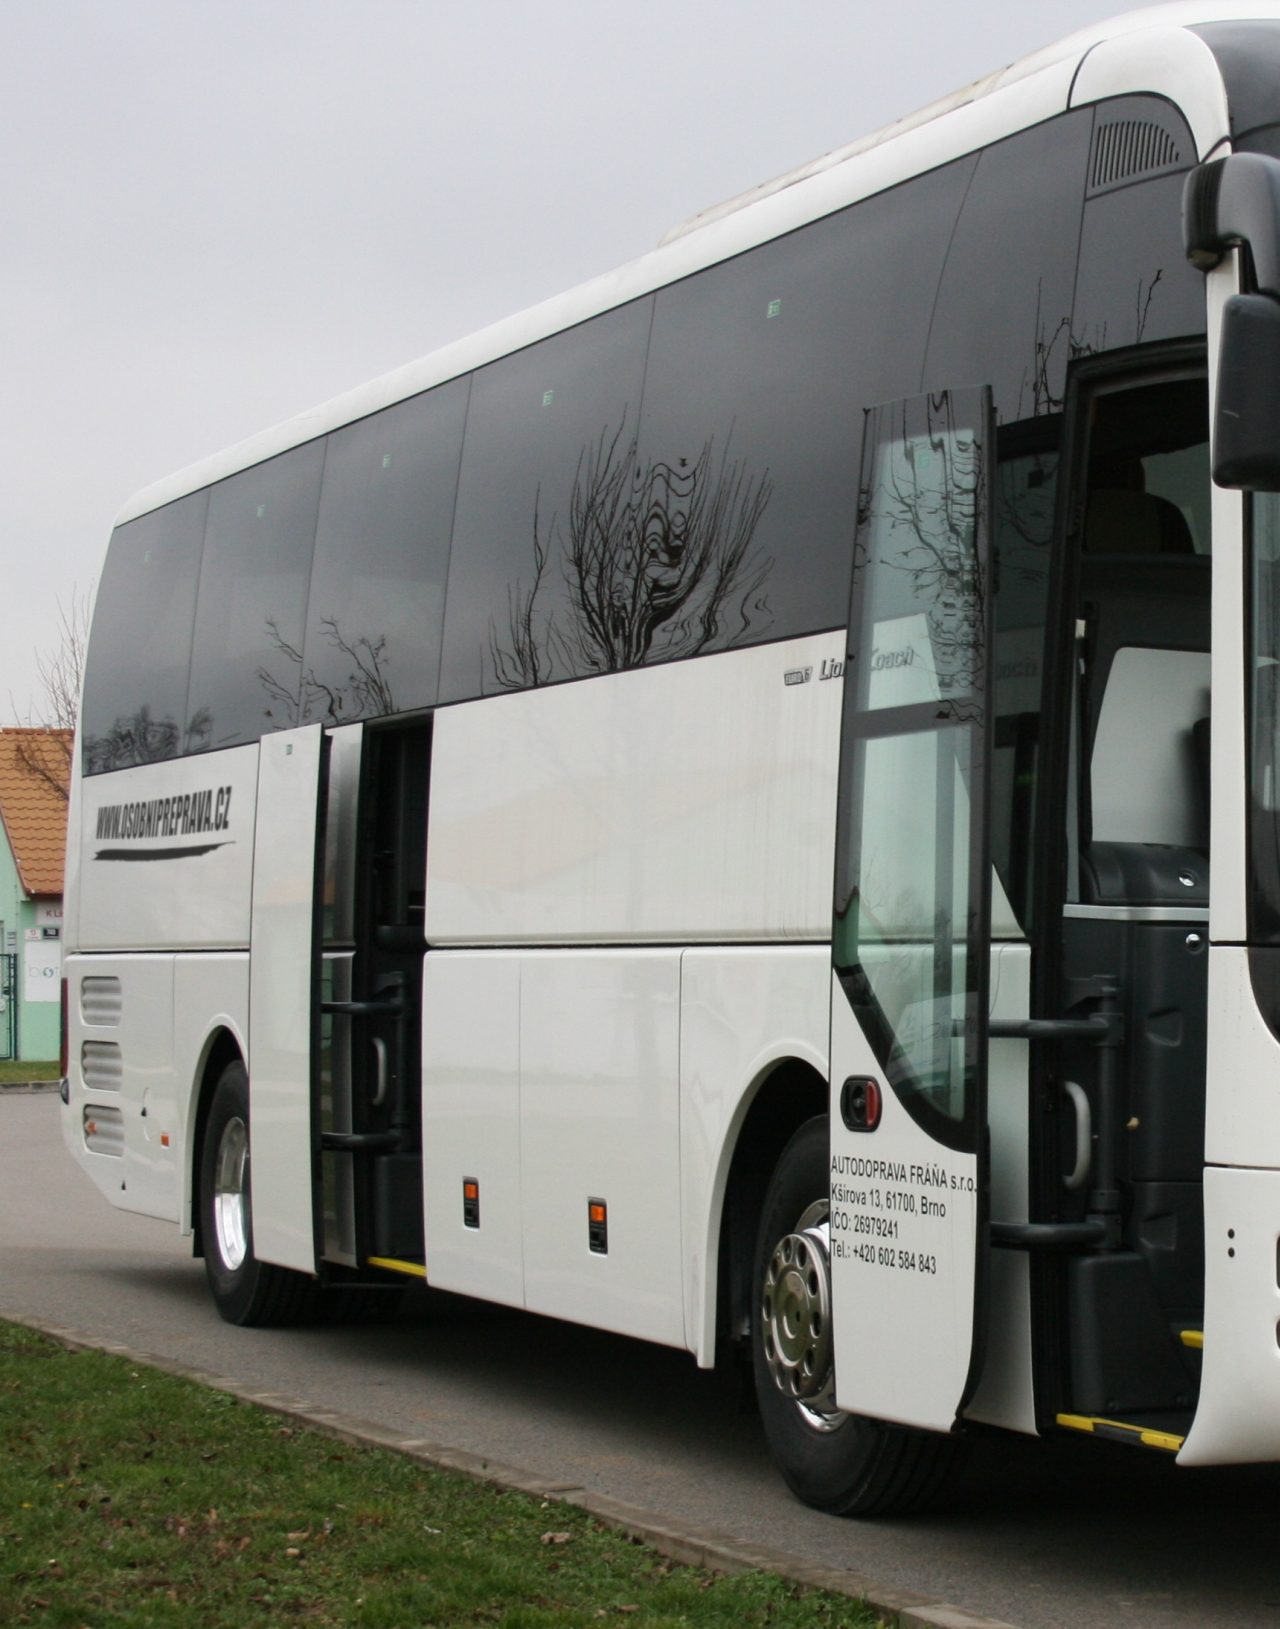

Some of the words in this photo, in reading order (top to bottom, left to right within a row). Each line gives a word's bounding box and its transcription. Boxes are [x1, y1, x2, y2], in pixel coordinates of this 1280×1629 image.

[96, 785, 232, 840] WWW.OSOBNIPREPRAVA.CZ
[831, 1155, 907, 1183] AUTODOPRAVA
[910, 1162, 948, 1188] FRÁŇA
[950, 1175, 977, 1193] s.r.o.
[869, 1188, 883, 1211] 13,
[886, 1190, 918, 1217] 61700,
[921, 1195, 946, 1217] Brno
[831, 1207, 852, 1231] IČO:
[854, 1214, 898, 1239] 26979241
[831, 1238, 850, 1258] Tel.:
[853, 1243, 876, 1263] +420
[878, 1246, 896, 1267] 602
[898, 1250, 916, 1271] 584
[918, 1253, 937, 1275] 843
